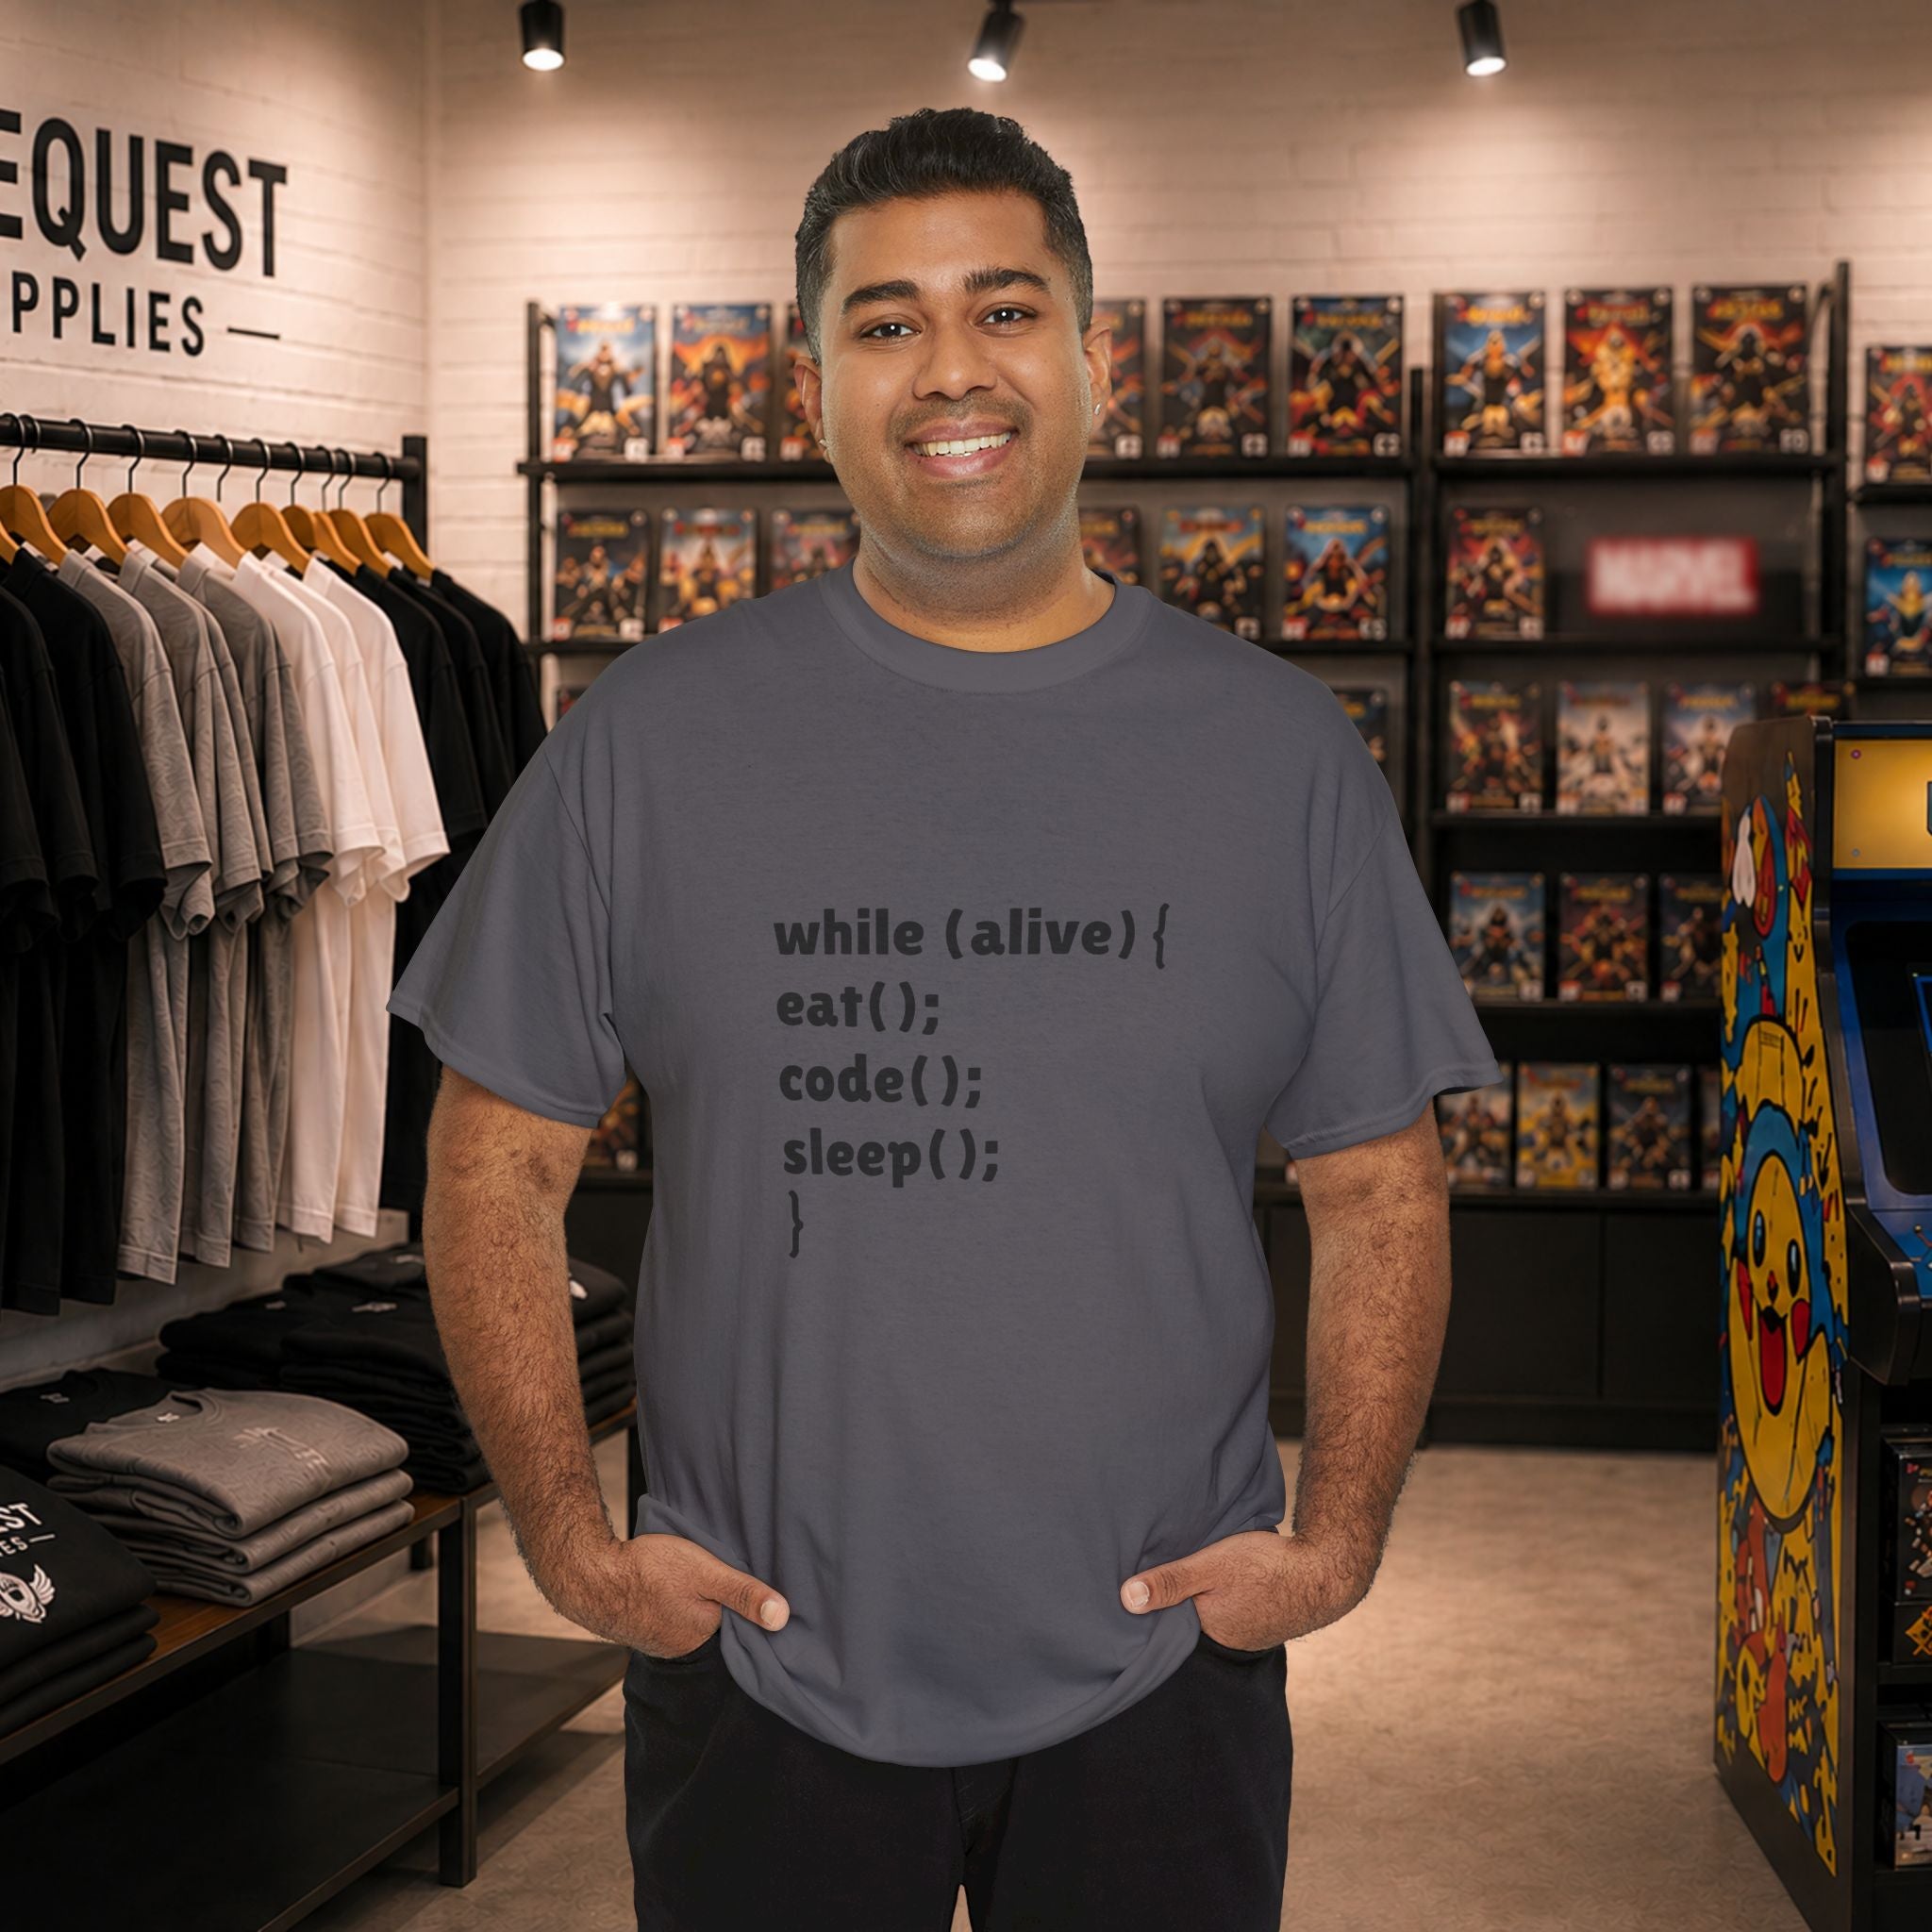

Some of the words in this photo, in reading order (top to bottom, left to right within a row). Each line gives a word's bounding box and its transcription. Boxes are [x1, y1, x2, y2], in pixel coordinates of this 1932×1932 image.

[773, 908, 924, 957] while
[945, 908, 1136, 960] (alive)
[1152, 903, 1171, 970] {
[776, 980, 940, 1036] eat();
[778, 1053, 982, 1109] code();
[783, 1126, 999, 1189] sleep();
[788, 1190, 805, 1259] }
